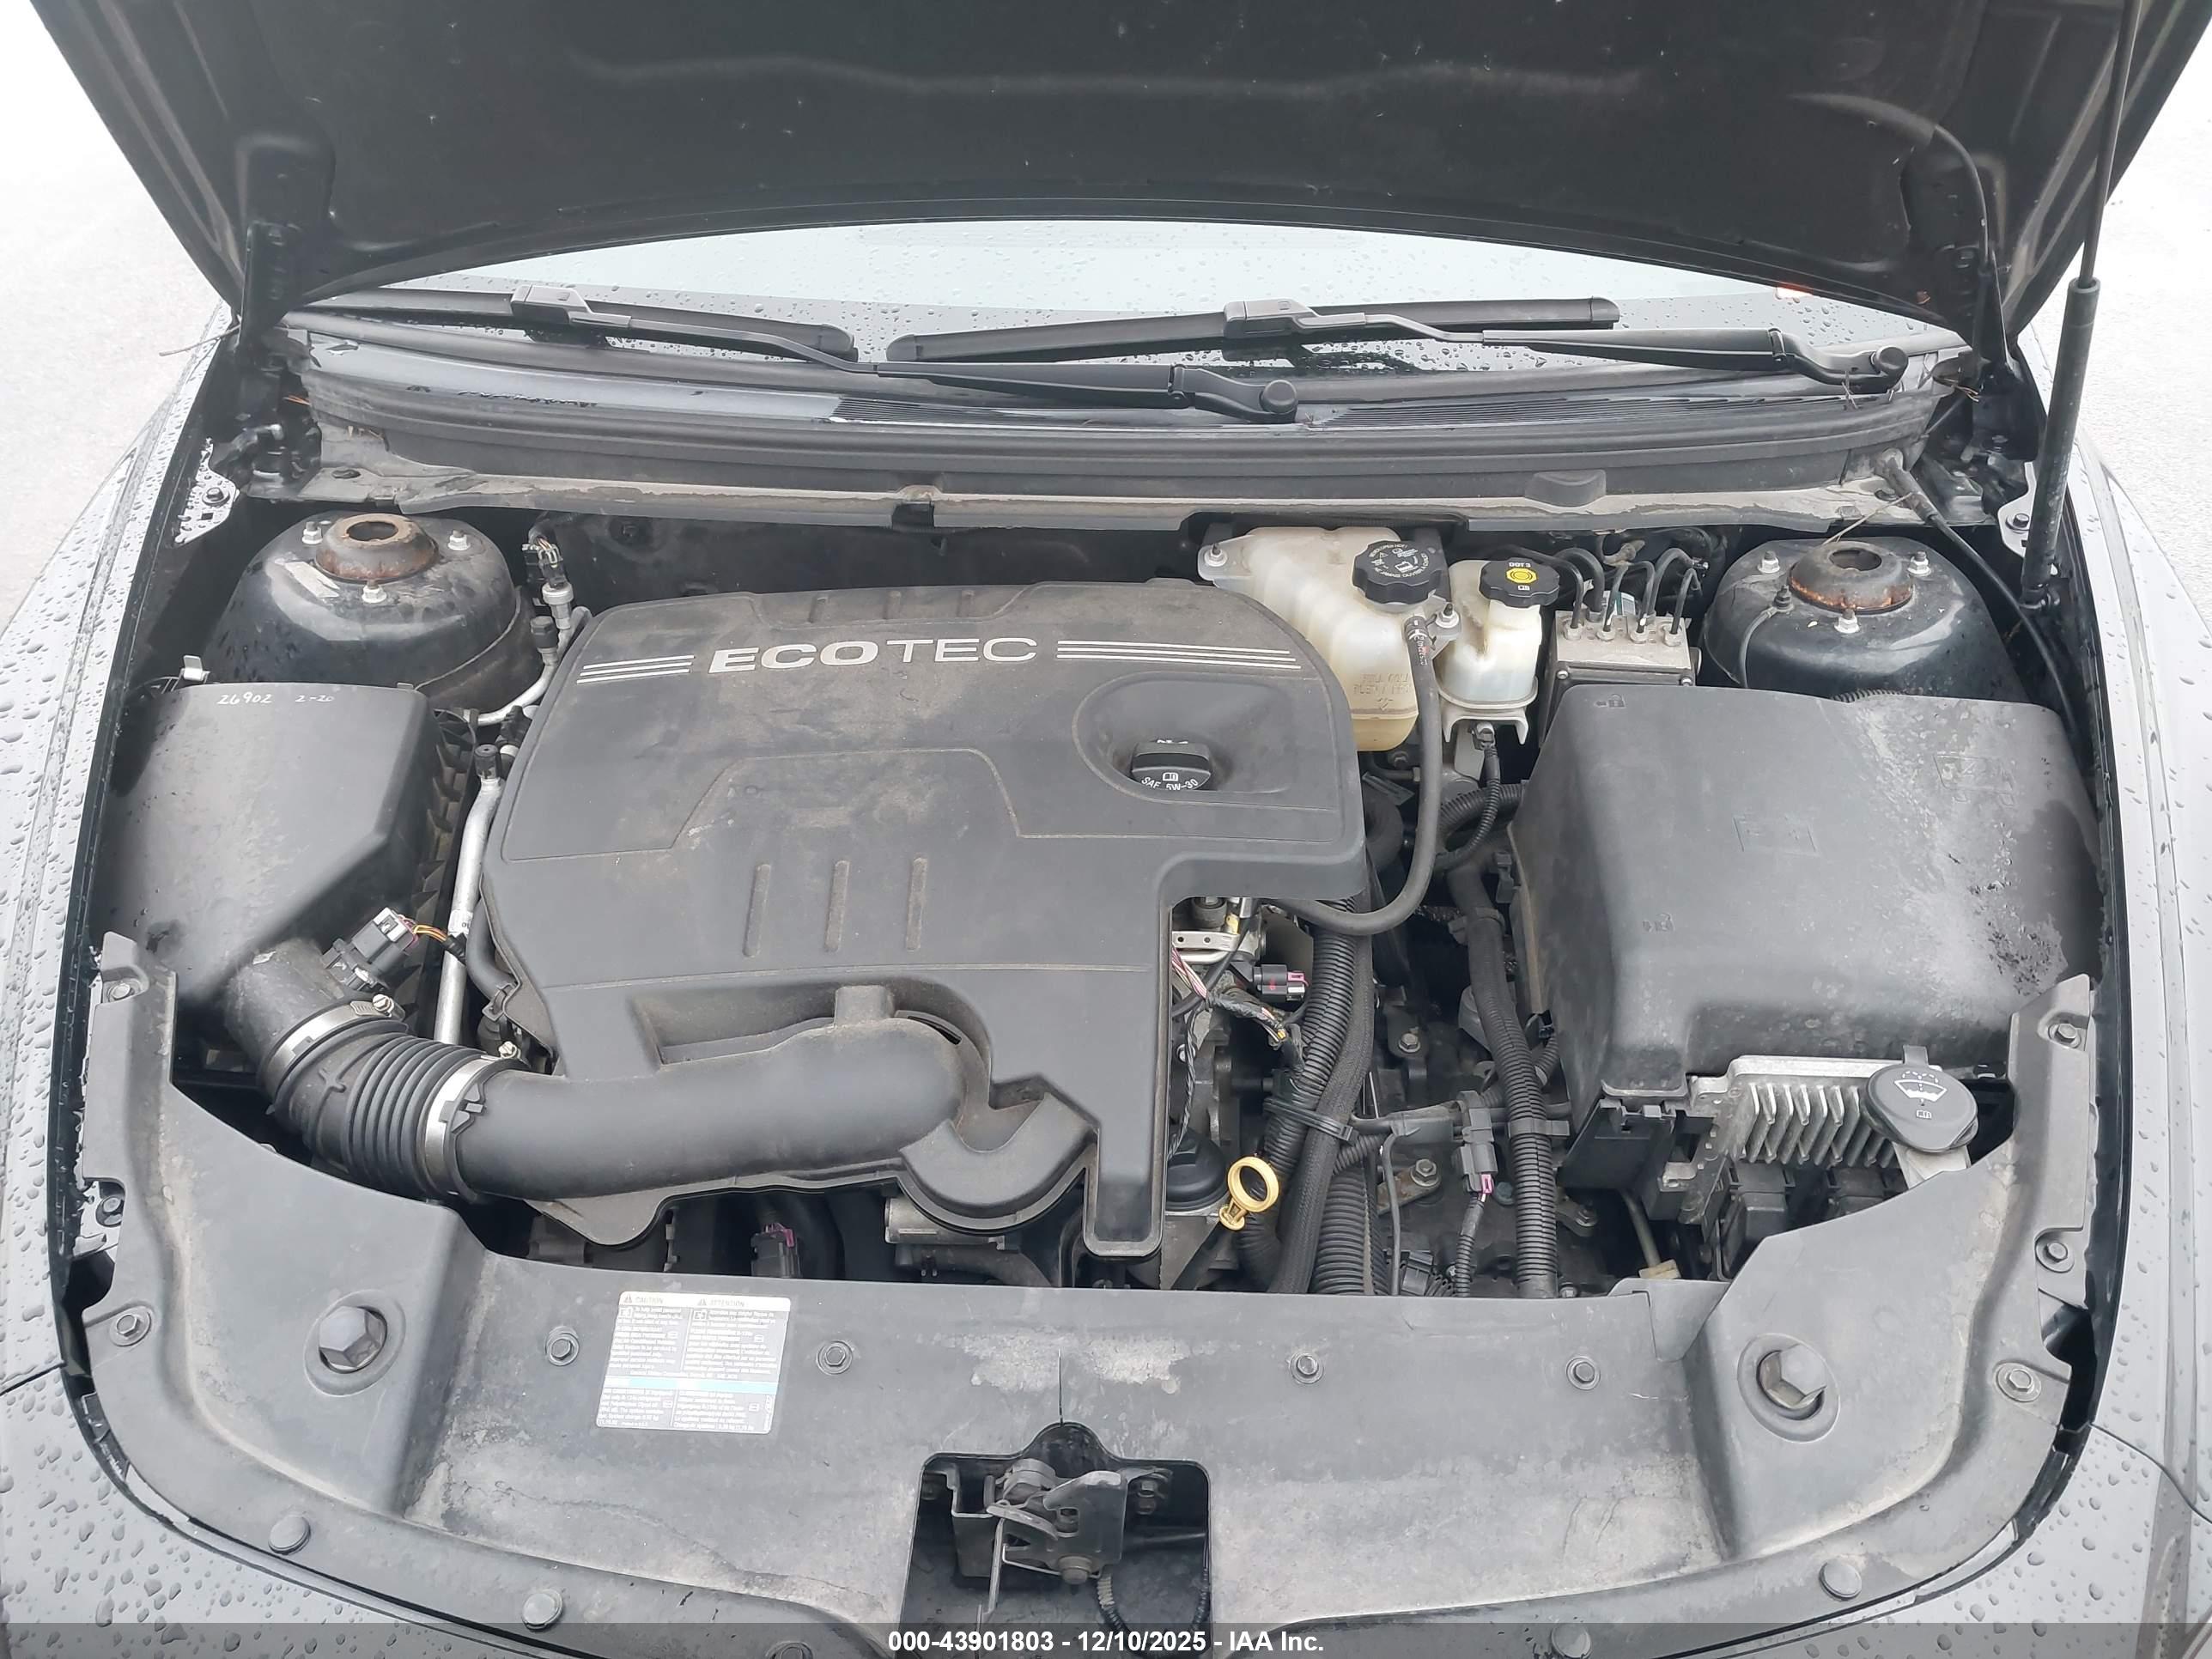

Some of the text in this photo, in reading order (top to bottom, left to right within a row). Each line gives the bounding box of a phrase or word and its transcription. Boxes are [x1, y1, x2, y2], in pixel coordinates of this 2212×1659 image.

[708, 637, 1038, 673] ECOTEC
[217, 691, 272, 705] 26902
[1166, 778, 1199, 790] 5W-30
[635, 1296, 665, 1304] CAUTION
